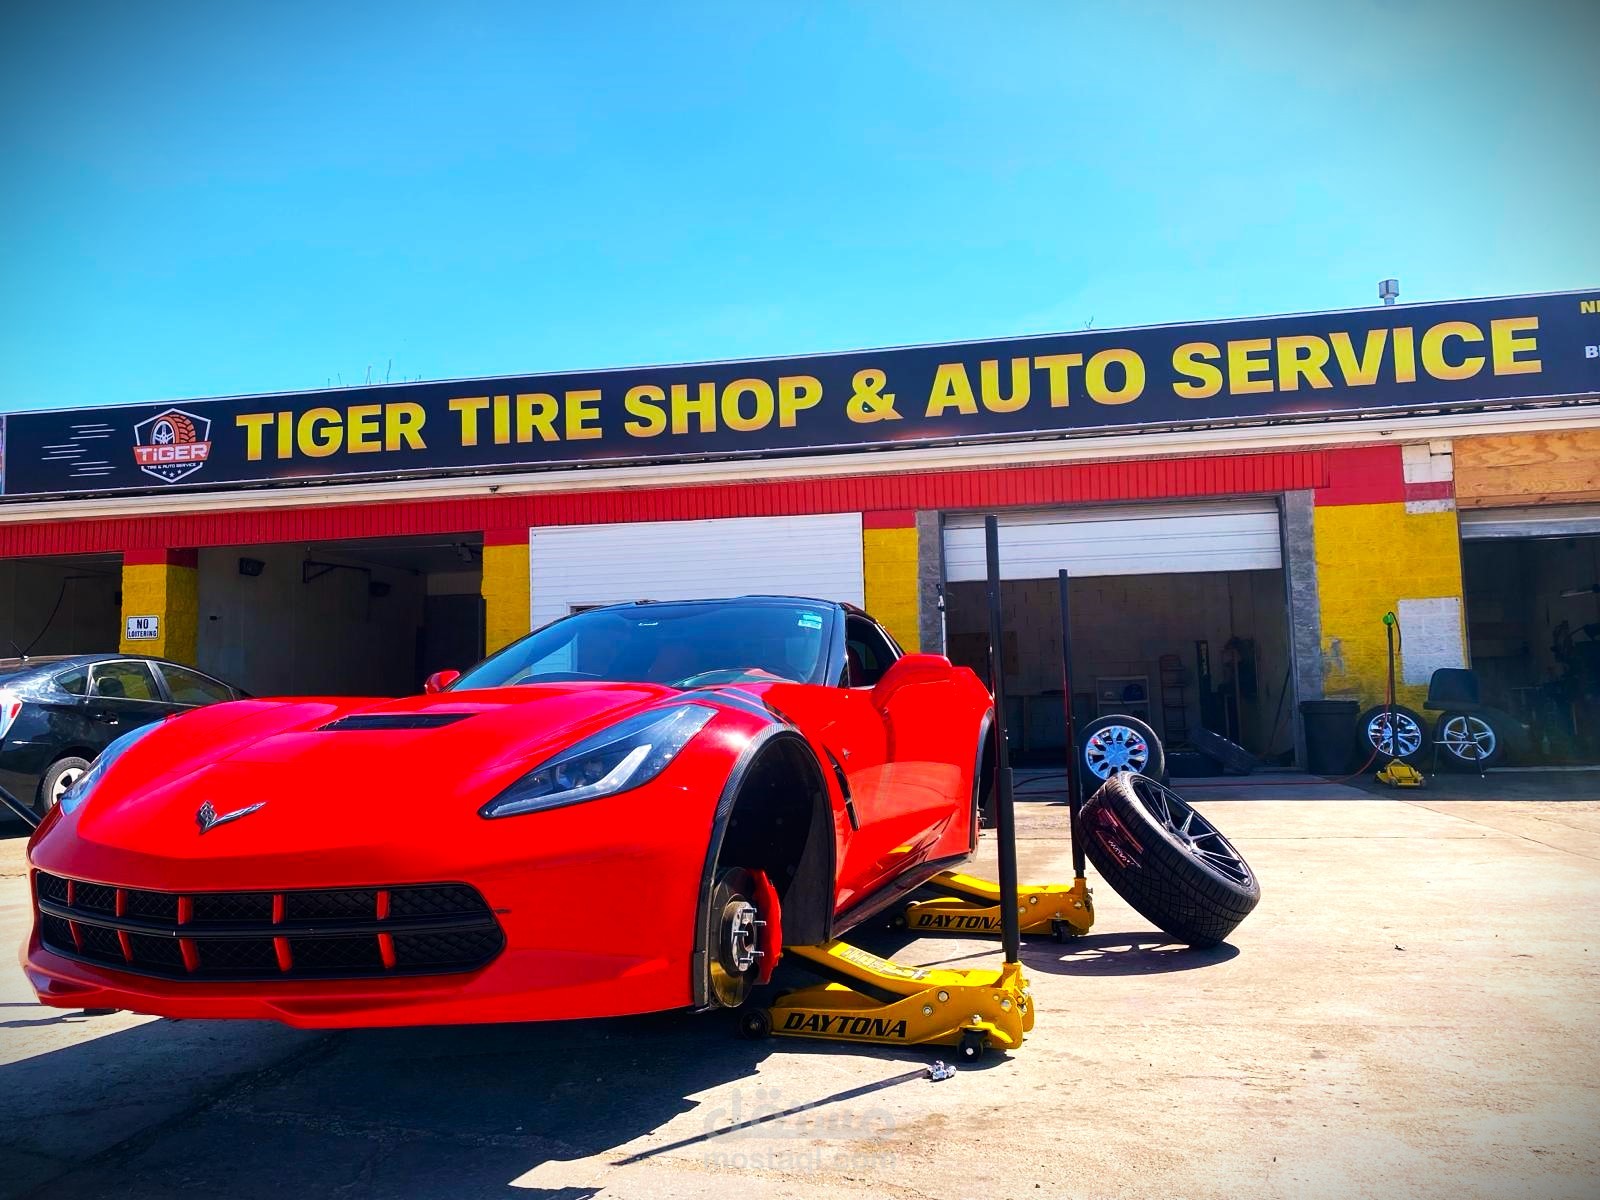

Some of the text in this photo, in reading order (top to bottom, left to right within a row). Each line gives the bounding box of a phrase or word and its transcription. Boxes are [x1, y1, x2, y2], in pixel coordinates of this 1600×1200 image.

[235, 316, 1542, 461] TIGER TIRE SHOP & AUTO SERVICE
[136, 619, 149, 629] NO
[783, 1012, 907, 1038] DAYTONA
